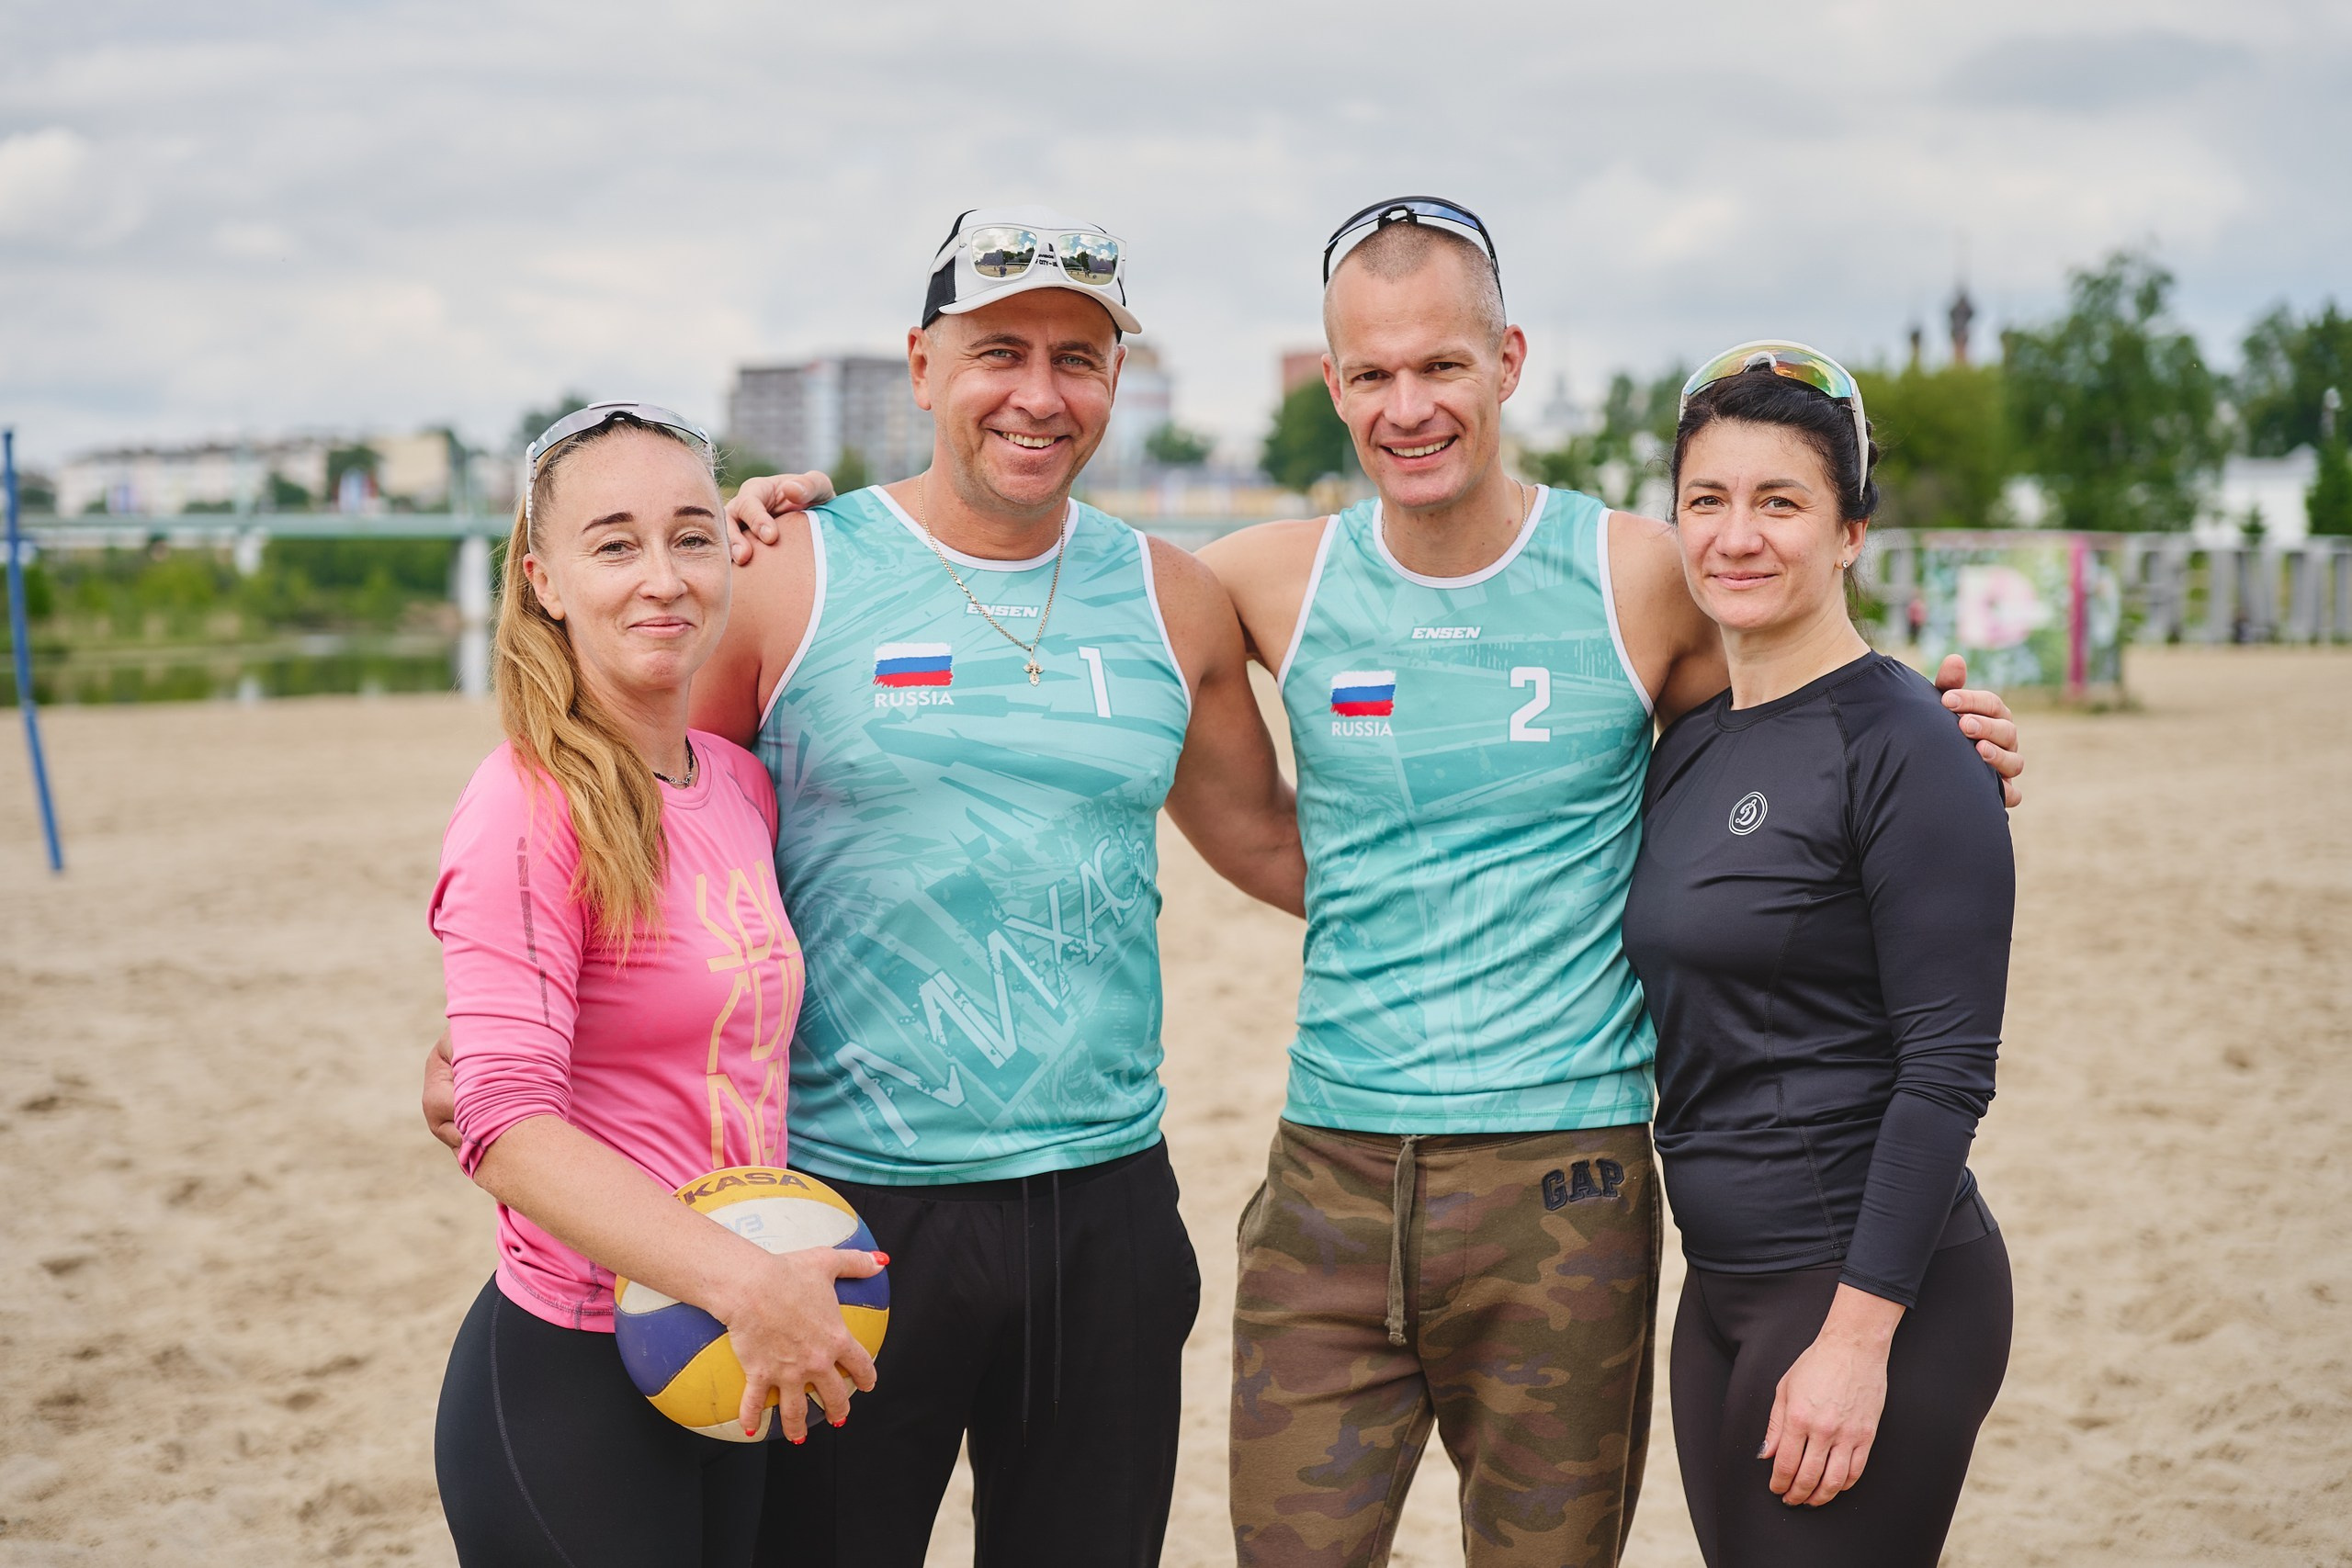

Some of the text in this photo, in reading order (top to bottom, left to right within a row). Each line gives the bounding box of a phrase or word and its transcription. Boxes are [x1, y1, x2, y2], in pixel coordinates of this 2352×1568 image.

[966, 603, 1040, 618] ENSEN
[1411, 626, 1482, 640] ENSEN
[1078, 646, 1112, 718] 1
[874, 690, 955, 708] RUSSIA
[1510, 666, 1551, 742] 2
[1331, 721, 1394, 737] RUSSIA
[675, 1172, 810, 1205] KASA
[1541, 1157, 1624, 1211] GAP
